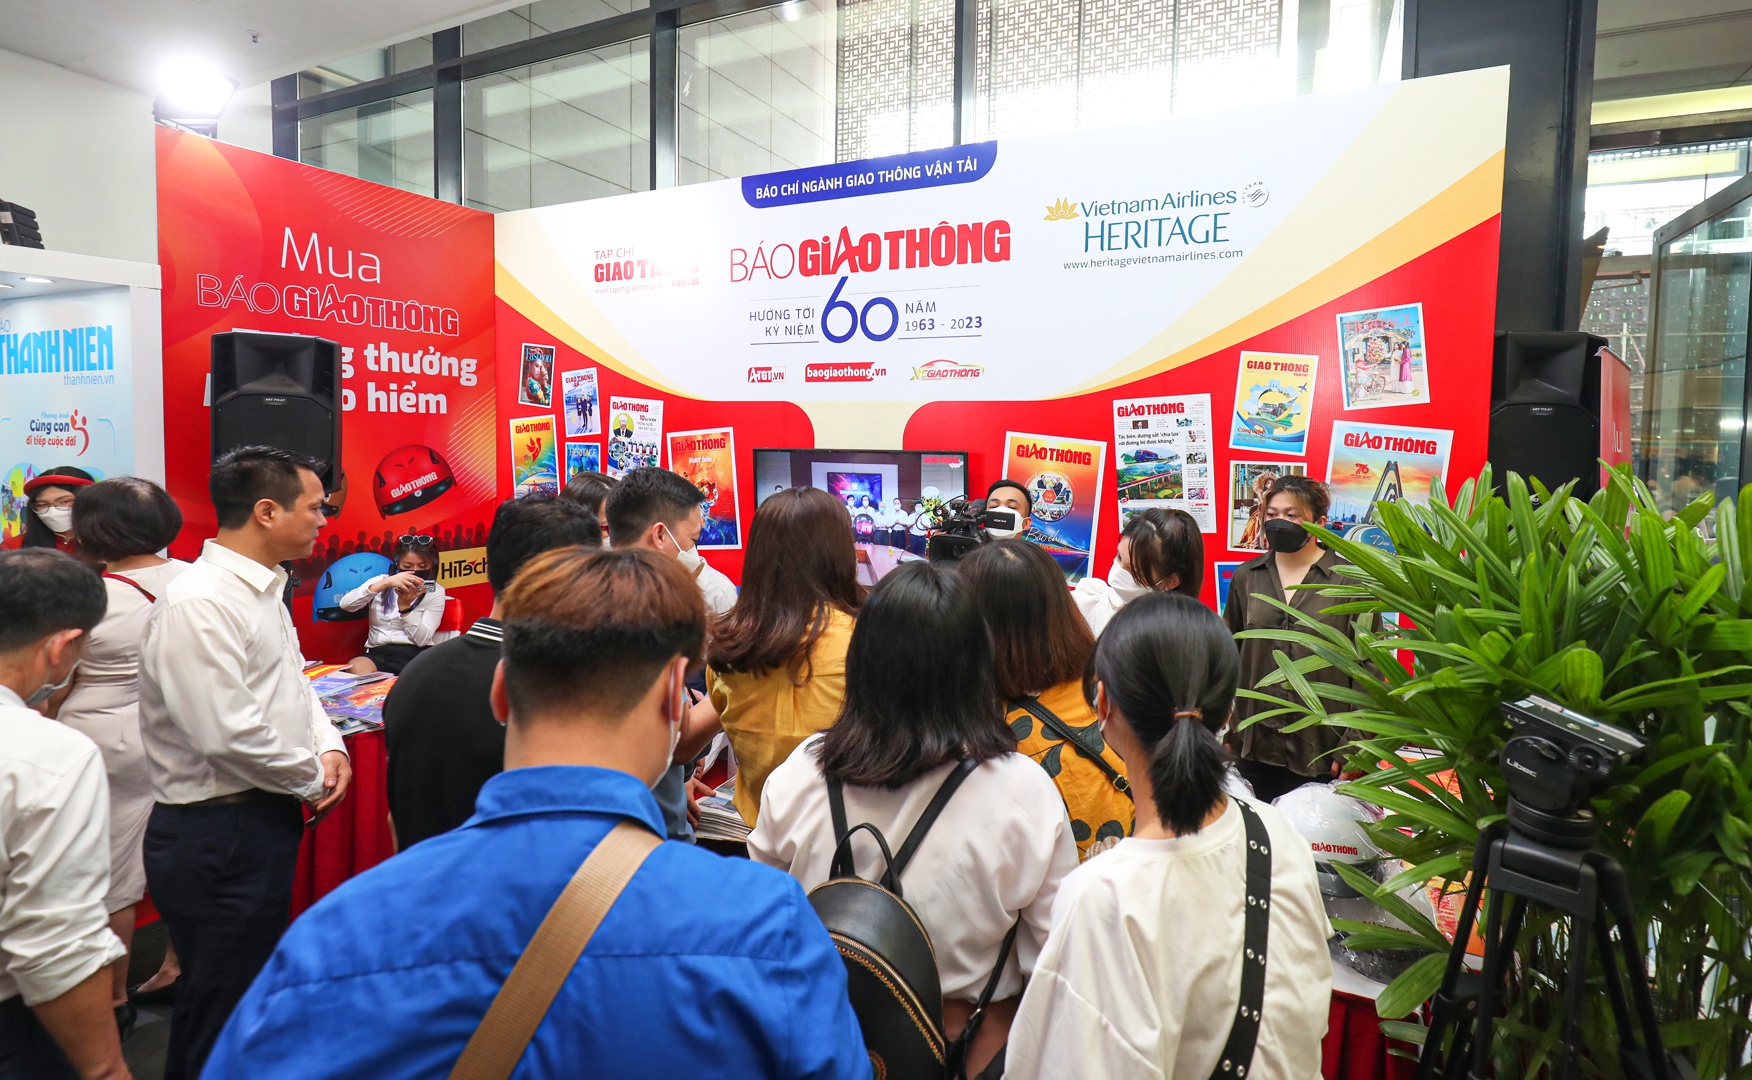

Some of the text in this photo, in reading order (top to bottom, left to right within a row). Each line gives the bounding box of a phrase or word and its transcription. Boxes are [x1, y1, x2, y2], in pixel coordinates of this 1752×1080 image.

[756, 155, 978, 200] BÁO CHÍ NGÀNH GIAO THÔNG VẬN TẢI
[1080, 189, 1237, 218] Vietnam Airlines
[1084, 211, 1231, 253] HERITAGE
[281, 226, 381, 284] Mua
[594, 249, 614, 262] TẠP
[730, 240, 795, 283] BÁO
[1063, 249, 1243, 270] www.heritagevietnamairlines.com
[594, 260, 634, 283] GIAO
[196, 273, 280, 314] BÁO
[749, 306, 815, 322] HƯỚNG TỚI
[821, 276, 899, 343] 60
[905, 300, 937, 315] NĂM
[785, 322, 815, 339] NIỆM
[905, 318, 936, 332] 1963
[950, 316, 983, 331] 2023
[364, 342, 478, 387] thưởng
[806, 365, 887, 381] baogiaothong.vn
[1246, 360, 1272, 371] GIAO
[64, 373, 115, 386] thanhnien.vn
[367, 381, 448, 415] hiểm
[30, 418, 70, 435] Cùng con
[1506, 757, 1537, 778] Libec
